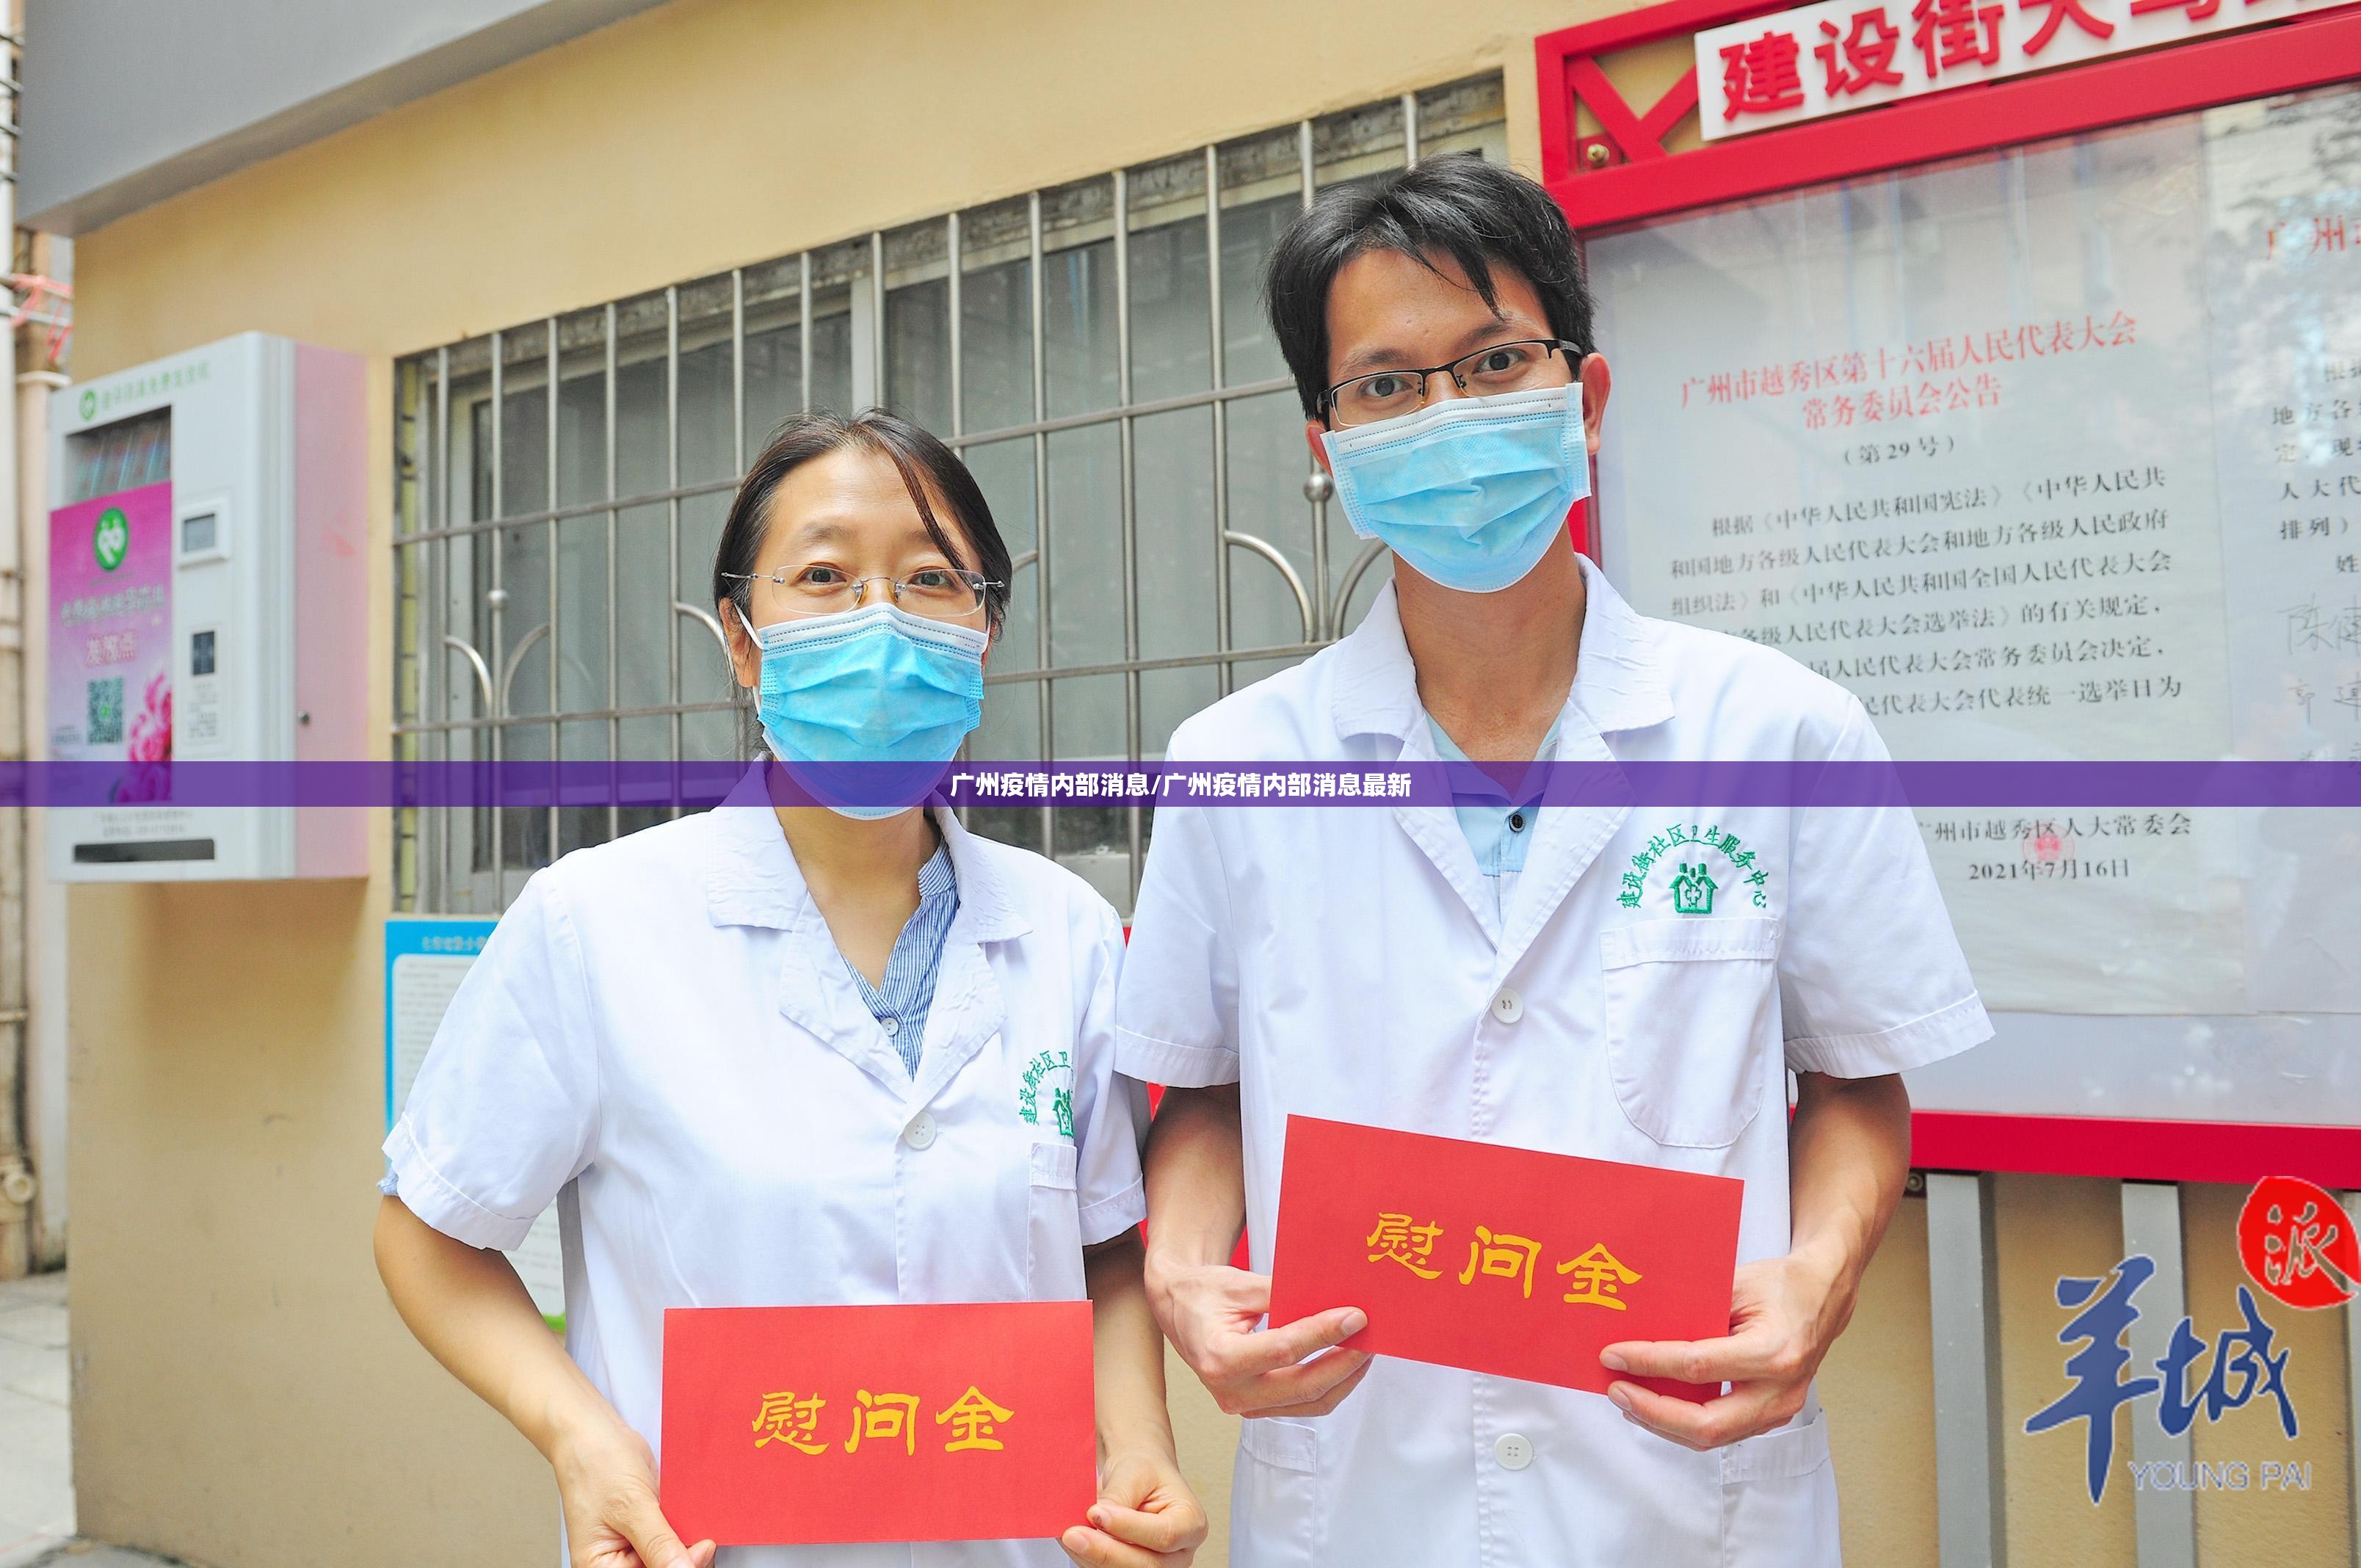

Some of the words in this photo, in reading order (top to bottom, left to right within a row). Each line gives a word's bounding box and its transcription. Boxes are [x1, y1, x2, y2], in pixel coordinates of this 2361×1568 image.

[1719, 0, 2271, 121] 建设街大
[2267, 215, 2361, 261] 广州
[1681, 310, 2138, 410] 广州市越秀区第十六届人民代表大会
[1802, 371, 2003, 430] 常务委员会公告
[2272, 399, 2361, 426] 地方各
[1671, 508, 2170, 579] 和国地方各级人民代表大会和地方各级人民政府
[1617, 823, 1769, 909] 建设街社区卫生服务中心
[1969, 857, 2130, 882] 2021年7月16日
[1366, 1211, 1643, 1311] 慰问金
[751, 1385, 1015, 1456] 慰问金
